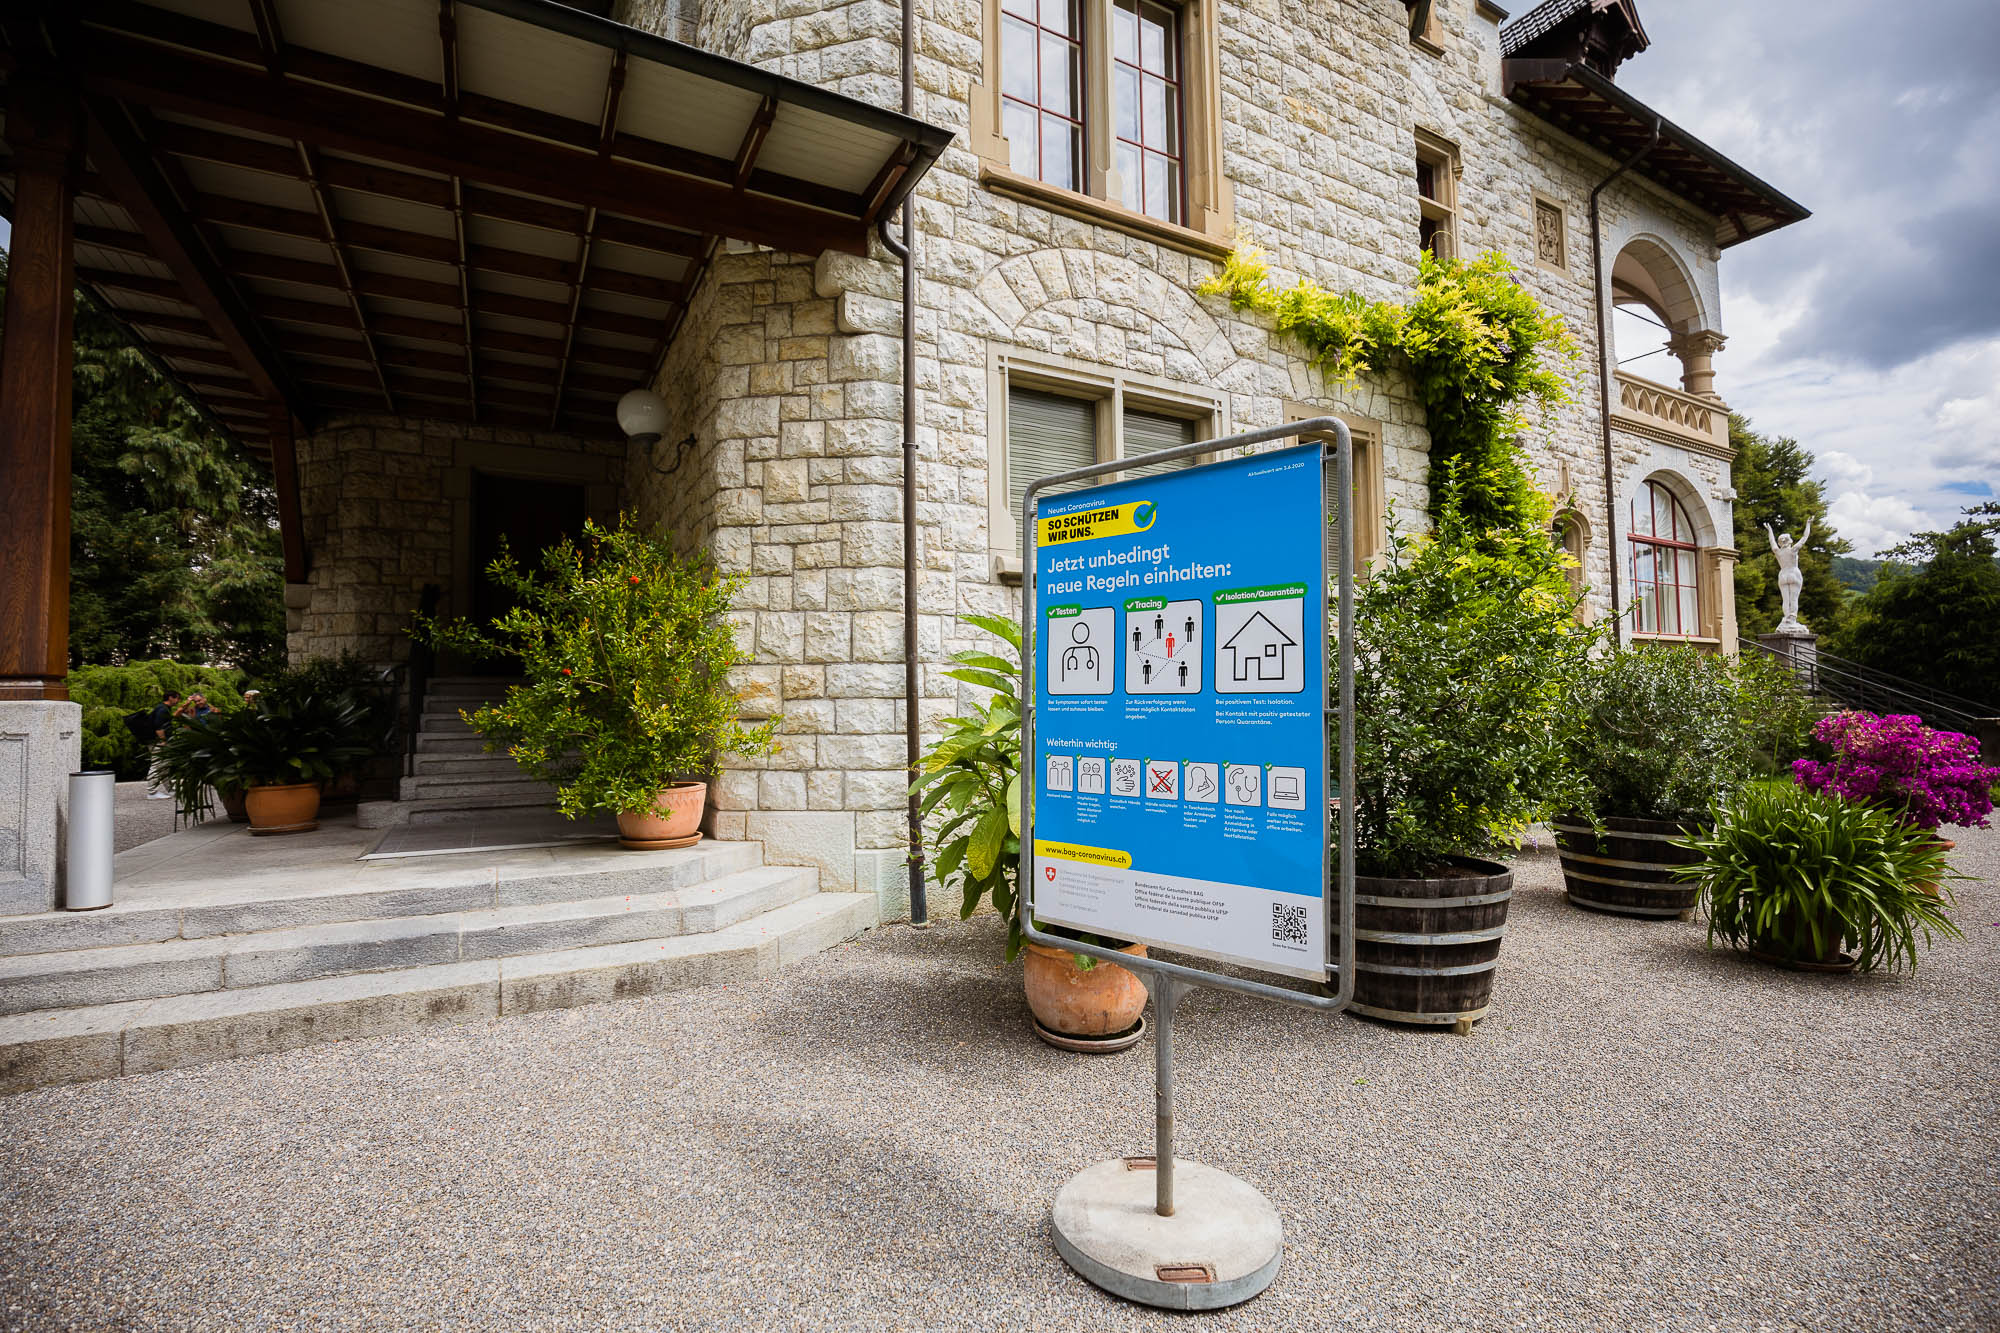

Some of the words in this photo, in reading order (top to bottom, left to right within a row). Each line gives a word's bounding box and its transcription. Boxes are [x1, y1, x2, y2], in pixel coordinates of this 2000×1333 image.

[1047, 505, 1067, 515] Neues
[1067, 498, 1105, 512] Coronavirus
[1048, 519, 1062, 531] SO
[1063, 508, 1119, 528] SCHÜTZEN
[1048, 530, 1068, 542] WIR
[1069, 526, 1095, 539] UNS.
[1047, 555, 1085, 574] Jetzt
[1088, 543, 1170, 568] unbedingt
[1047, 579, 1082, 595] neue
[1086, 570, 1140, 592] Regeln
[1143, 561, 1232, 585] einhalten:
[1225, 586, 1304, 601] Isolation/Quarantäne
[1055, 606, 1077, 616] Testen
[1134, 599, 1162, 610] Tracing
[1046, 738, 1084, 749] Weiterhin
[1085, 739, 1118, 751] wichtig:
[1045, 847, 1127, 864] www.bag-coronavirus.ch
